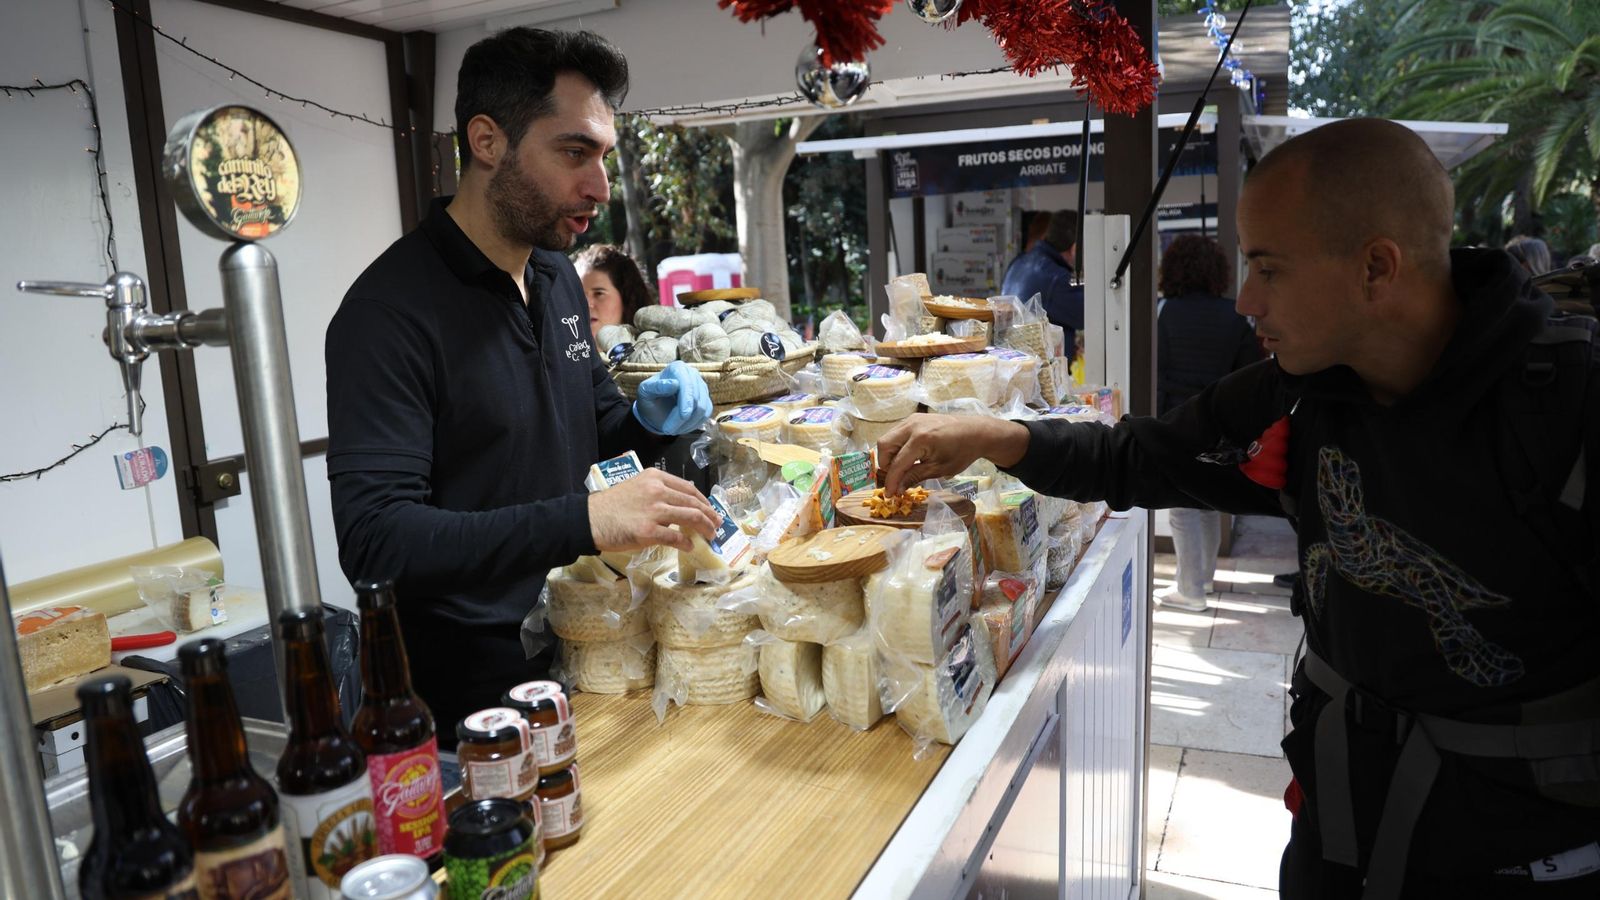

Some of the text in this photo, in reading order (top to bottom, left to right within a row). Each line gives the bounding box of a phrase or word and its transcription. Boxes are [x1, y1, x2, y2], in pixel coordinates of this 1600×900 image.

[958, 153, 1006, 167] FRUTOS
[1007, 147, 1051, 161] SECOS
[1019, 162, 1067, 176] ARRIATE
[237, 173, 277, 204] Rey
[1541, 856, 1558, 873] S
